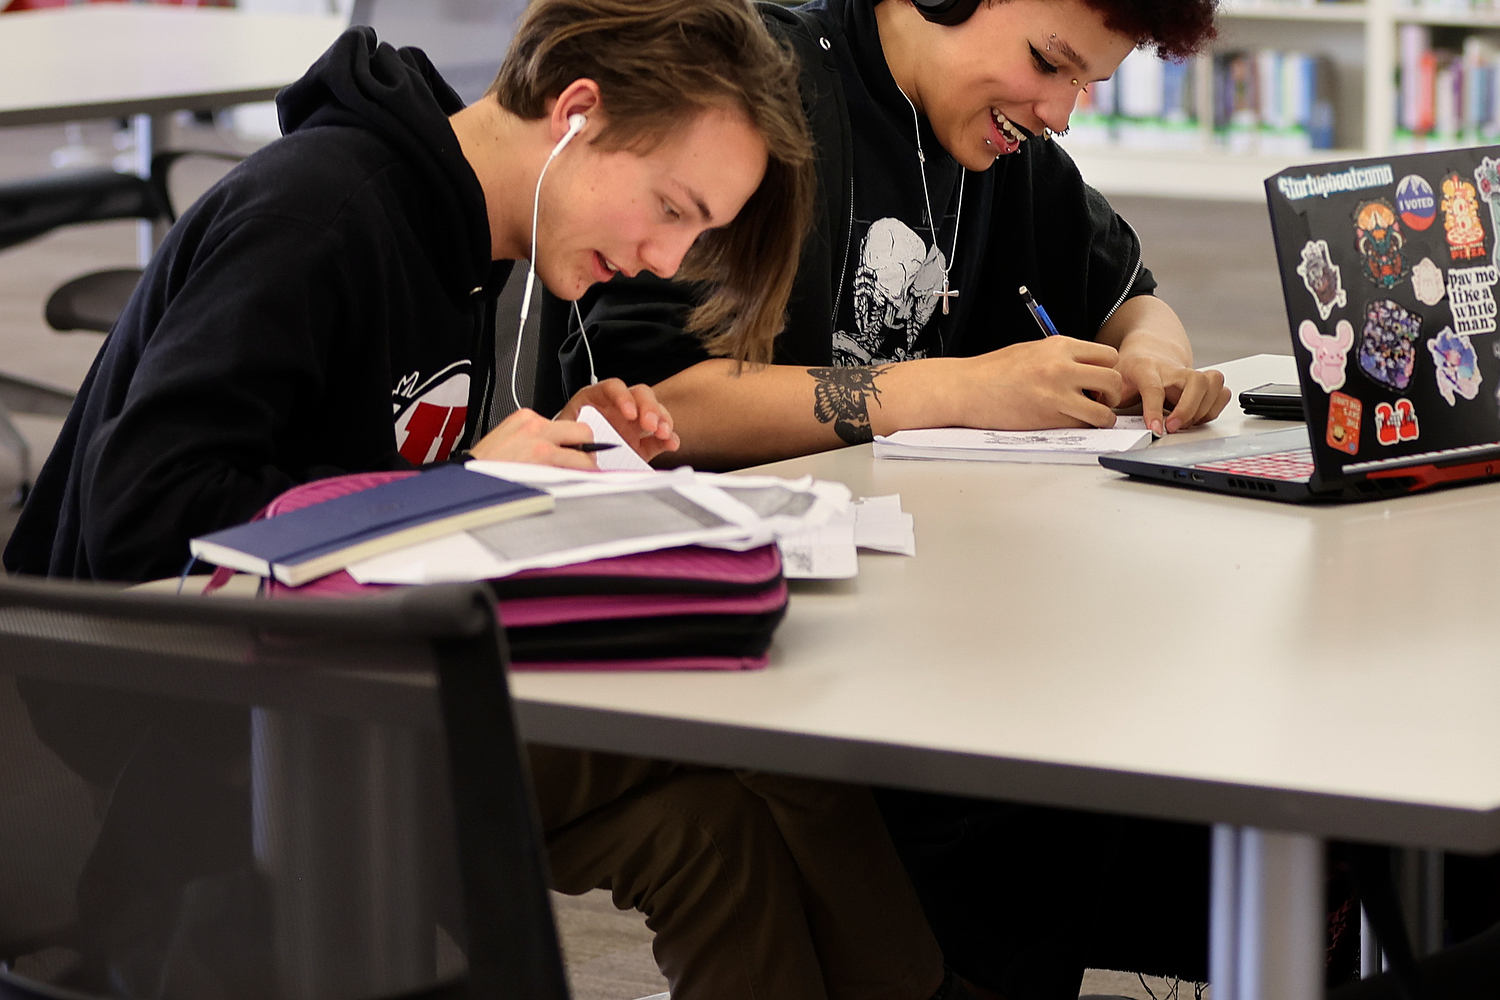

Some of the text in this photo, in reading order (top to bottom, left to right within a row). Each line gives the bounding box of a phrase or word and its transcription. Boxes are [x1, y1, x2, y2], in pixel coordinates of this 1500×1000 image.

[1404, 197, 1434, 211] VOTED
[1449, 270, 1495, 289] pay me
[1452, 287, 1490, 304] like a
[1455, 302, 1494, 332] white man.
